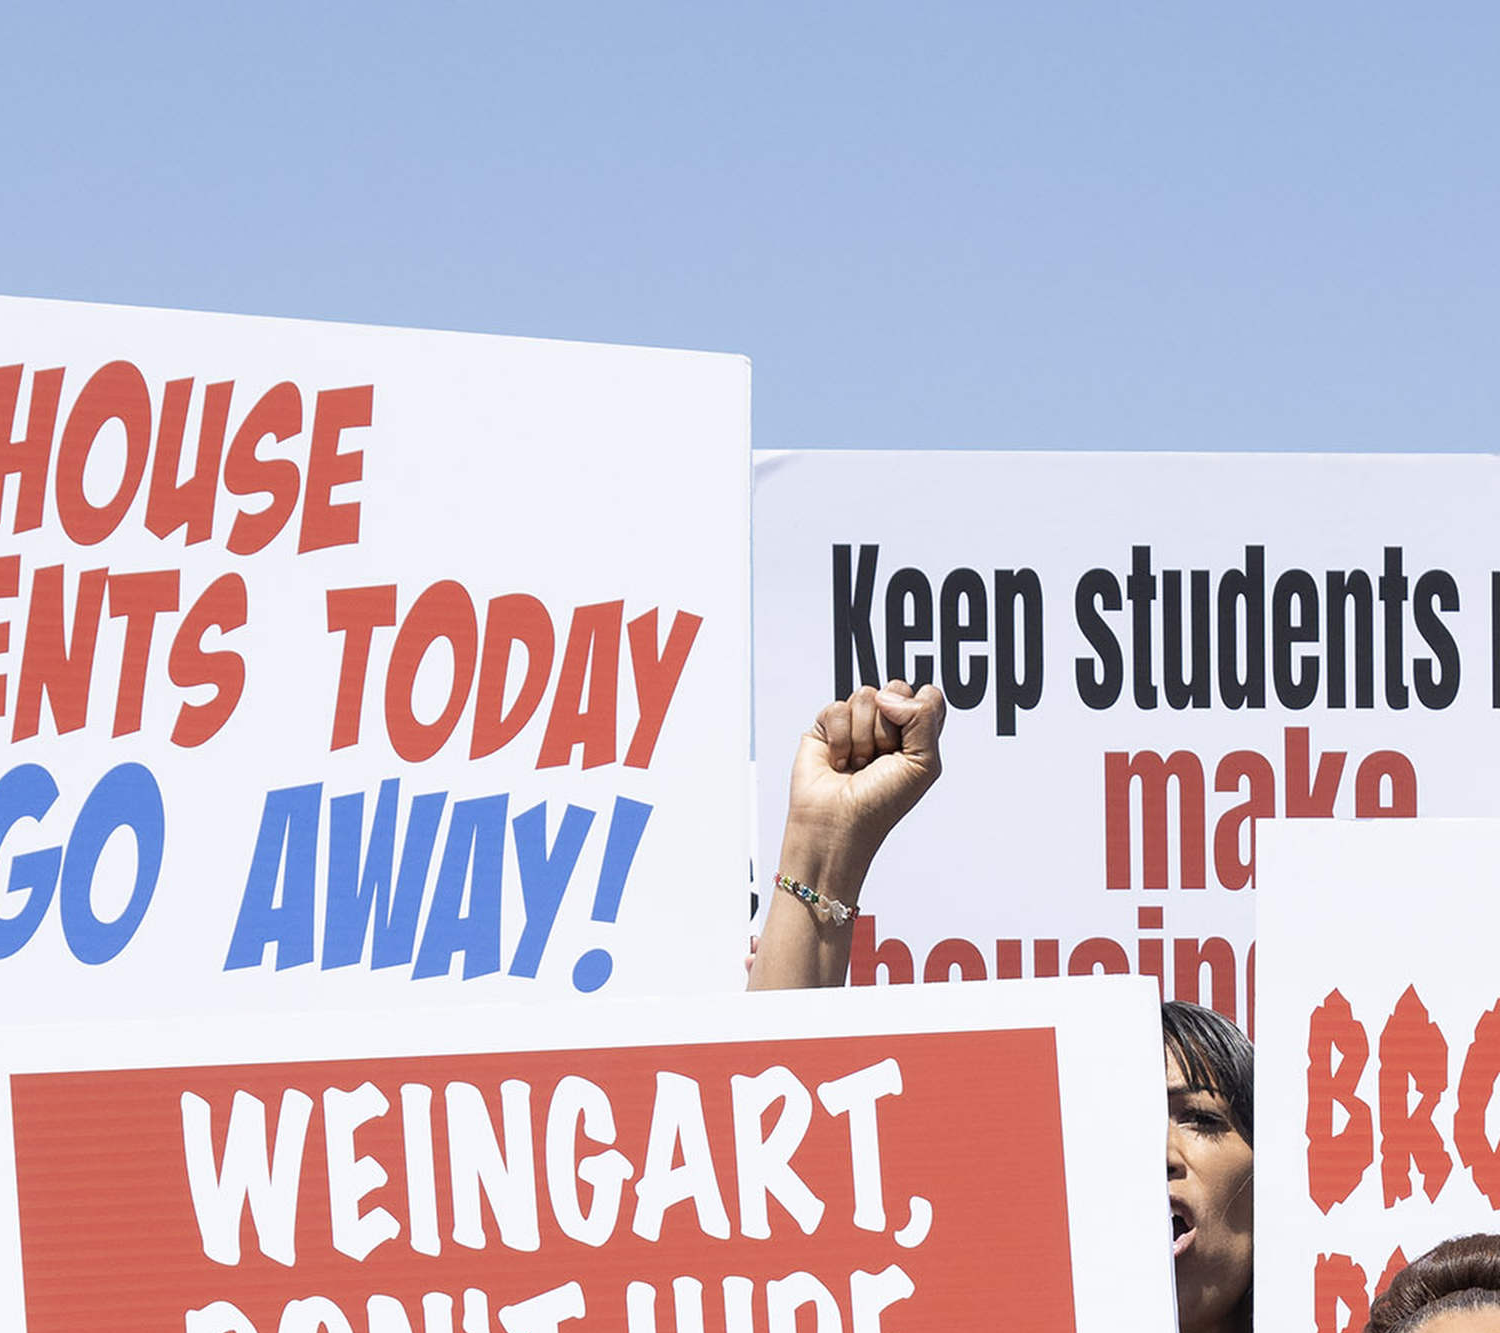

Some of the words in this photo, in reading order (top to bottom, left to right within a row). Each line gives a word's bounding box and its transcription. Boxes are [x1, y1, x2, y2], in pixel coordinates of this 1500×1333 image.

[326, 580, 702, 770] TODAY
[832, 545, 1044, 735] Keep
[1075, 545, 1460, 710] students
[223, 777, 653, 993] AWAY!
[181, 1058, 932, 1266] WEINGART,
